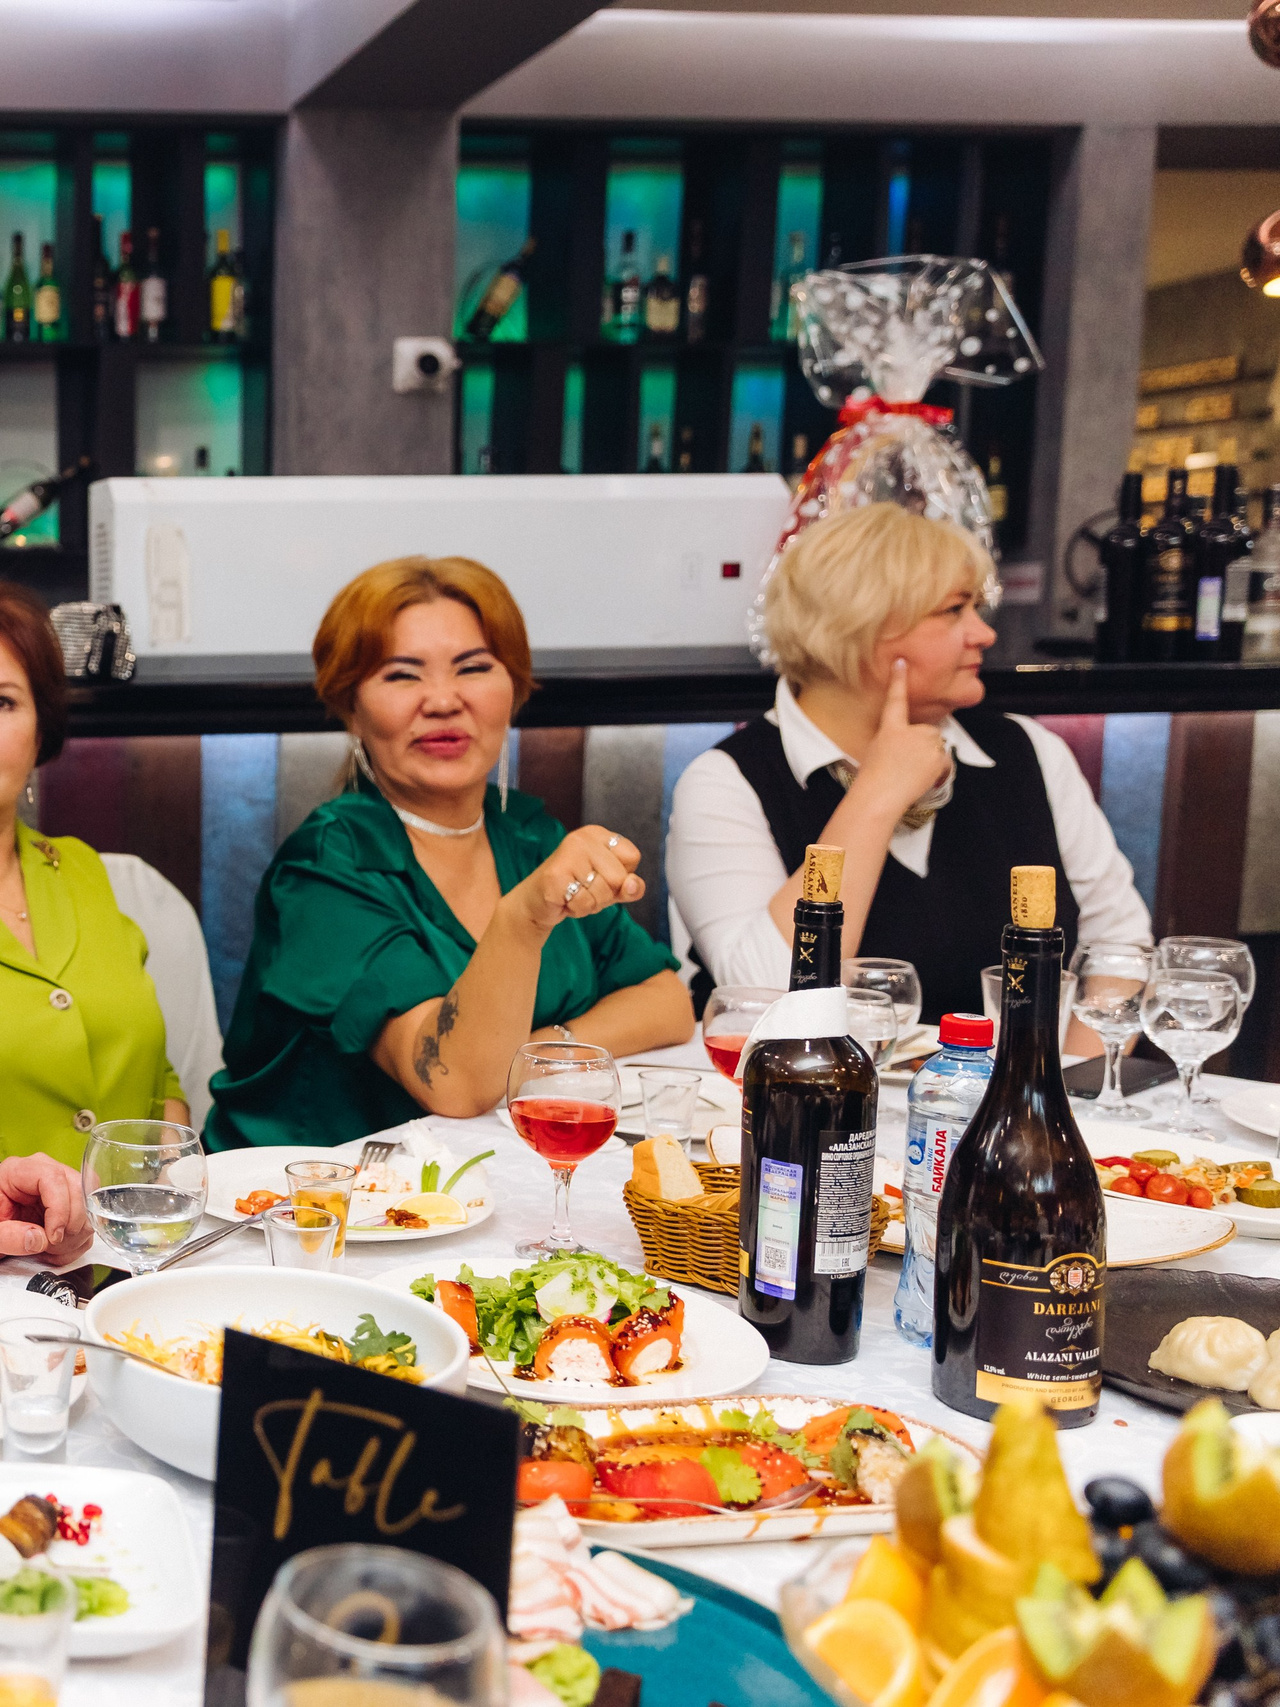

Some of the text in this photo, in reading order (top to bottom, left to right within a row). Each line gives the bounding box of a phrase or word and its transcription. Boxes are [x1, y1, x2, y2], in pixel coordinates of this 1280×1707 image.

[1033, 1298, 1100, 1316] DAREJANI
[1024, 1346, 1100, 1362] ALAZANI VALLEY
[1026, 1372, 1051, 1381] White
[1052, 1371, 1088, 1381] semi-sweet
[1001, 1382, 1034, 1393] PRODUCED
[1050, 1394, 1085, 1404] GEORGIA
[252, 1387, 467, 1540] Table
